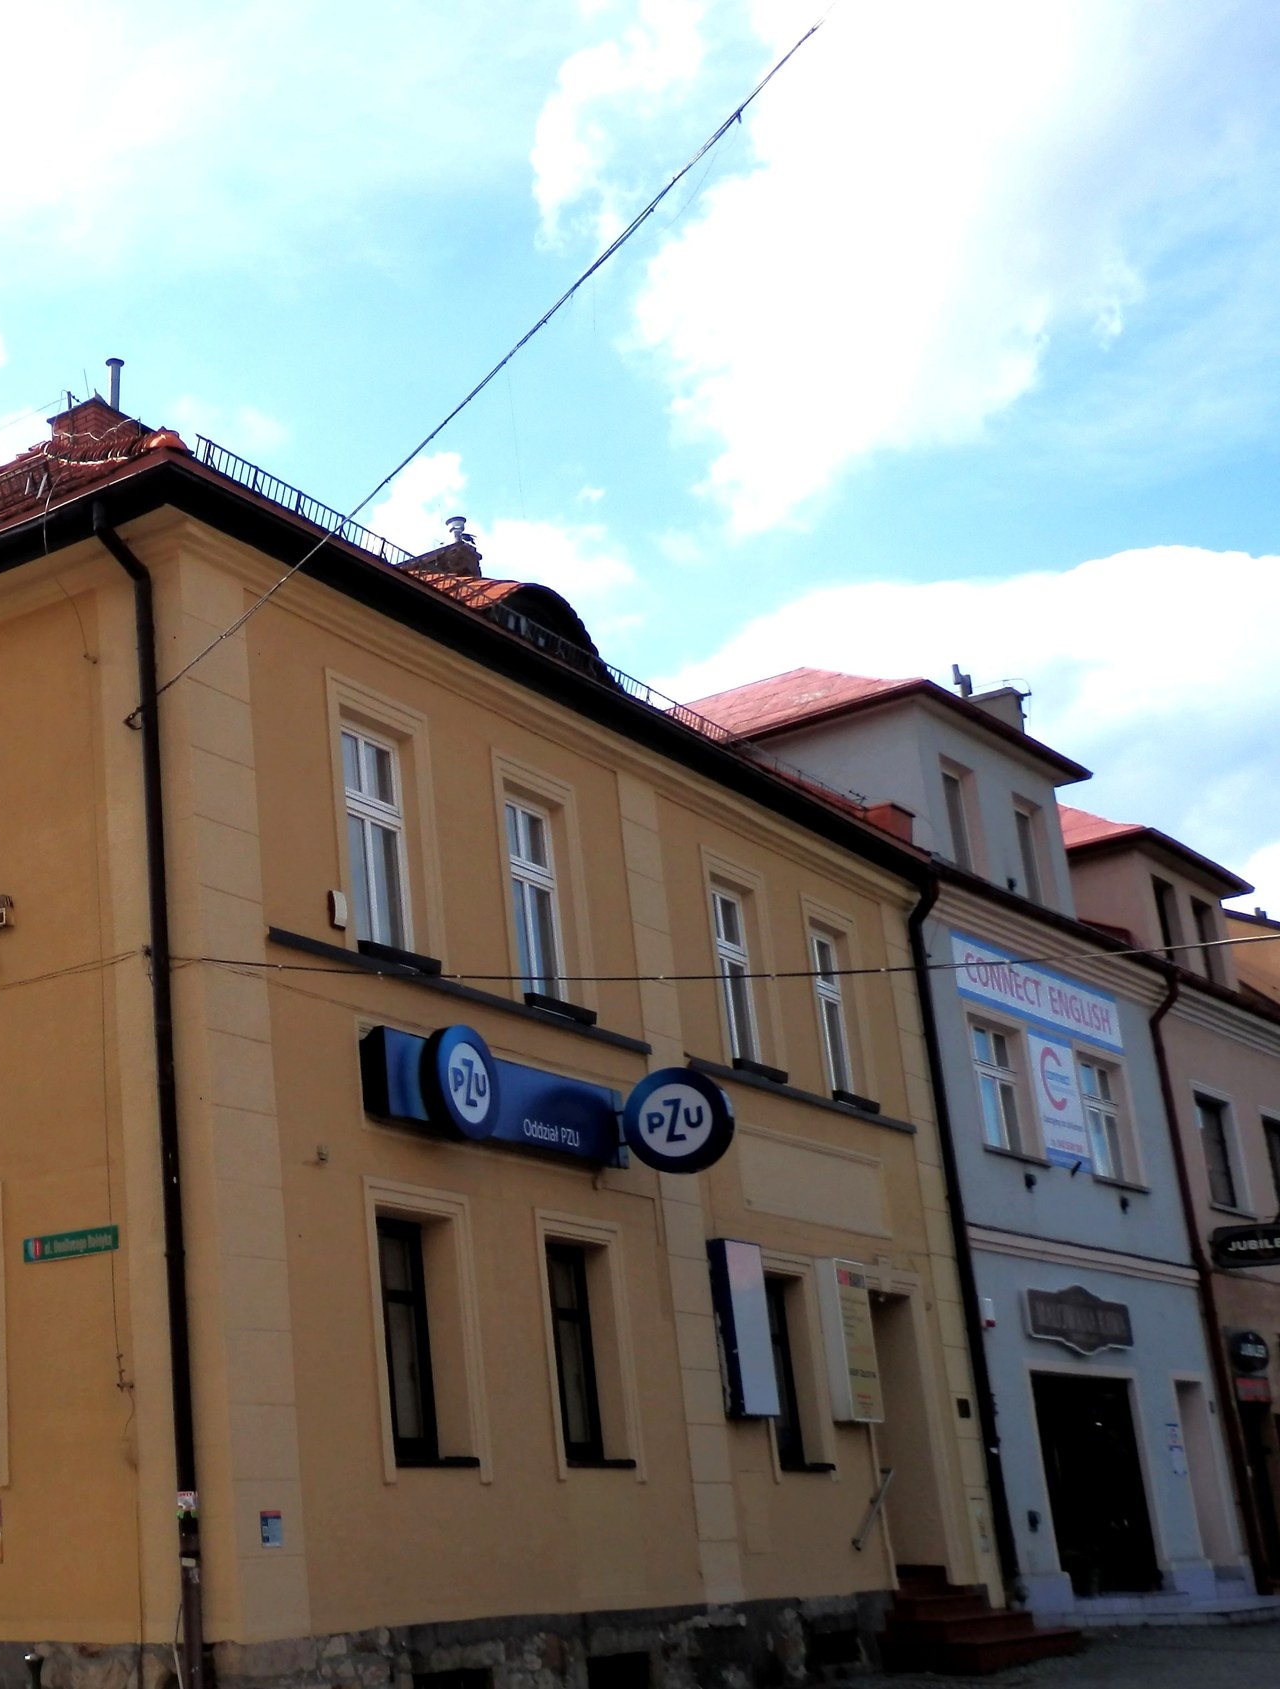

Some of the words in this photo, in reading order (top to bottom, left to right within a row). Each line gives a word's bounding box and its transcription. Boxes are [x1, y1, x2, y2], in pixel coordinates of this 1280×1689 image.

[964, 952, 1041, 1007] CONNECT
[1048, 986, 1112, 1033] ENGLISH
[451, 1057, 488, 1107] PZU
[523, 1117, 559, 1144] Oddział
[560, 1126, 580, 1148] PZU
[645, 1097, 704, 1143] PZU
